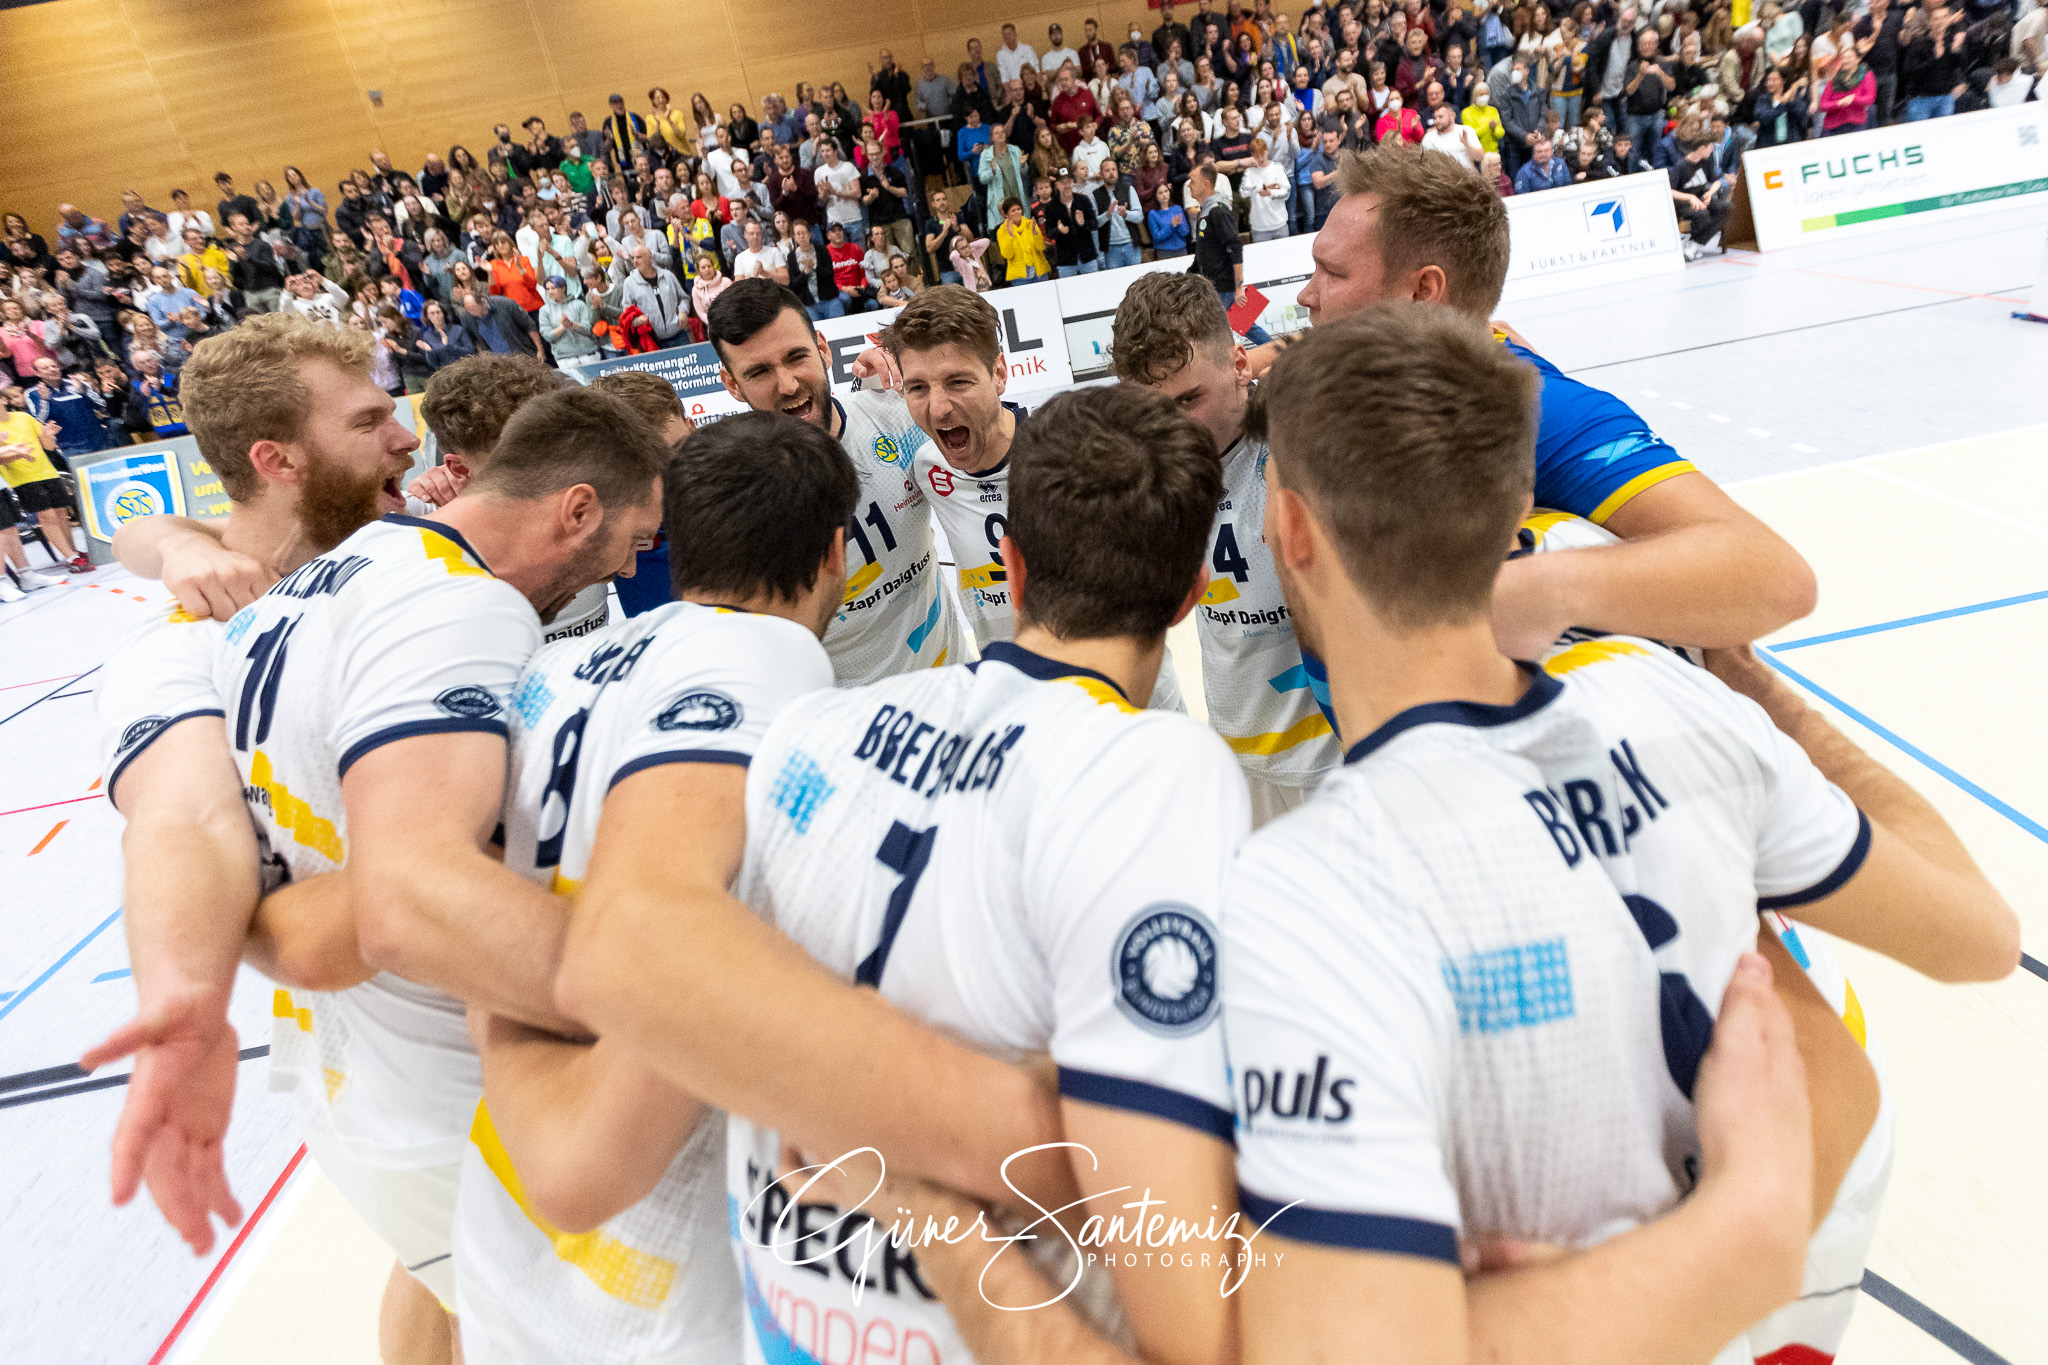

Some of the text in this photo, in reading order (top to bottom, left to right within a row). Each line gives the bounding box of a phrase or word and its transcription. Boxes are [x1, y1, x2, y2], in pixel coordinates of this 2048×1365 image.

[1801, 145, 1925, 184] FUCHS
[1592, 239, 1657, 259] PARTNER
[1010, 356, 1047, 378] nik
[194, 480, 224, 498] unt
[848, 501, 898, 566] 11
[1212, 523, 1250, 583] 4
[845, 588, 882, 612] Zapf
[882, 551, 931, 596] Daigfuss
[979, 589, 1007, 607] Zapf
[1205, 606, 1238, 626] Zapf
[1244, 1054, 1357, 1133] puls
